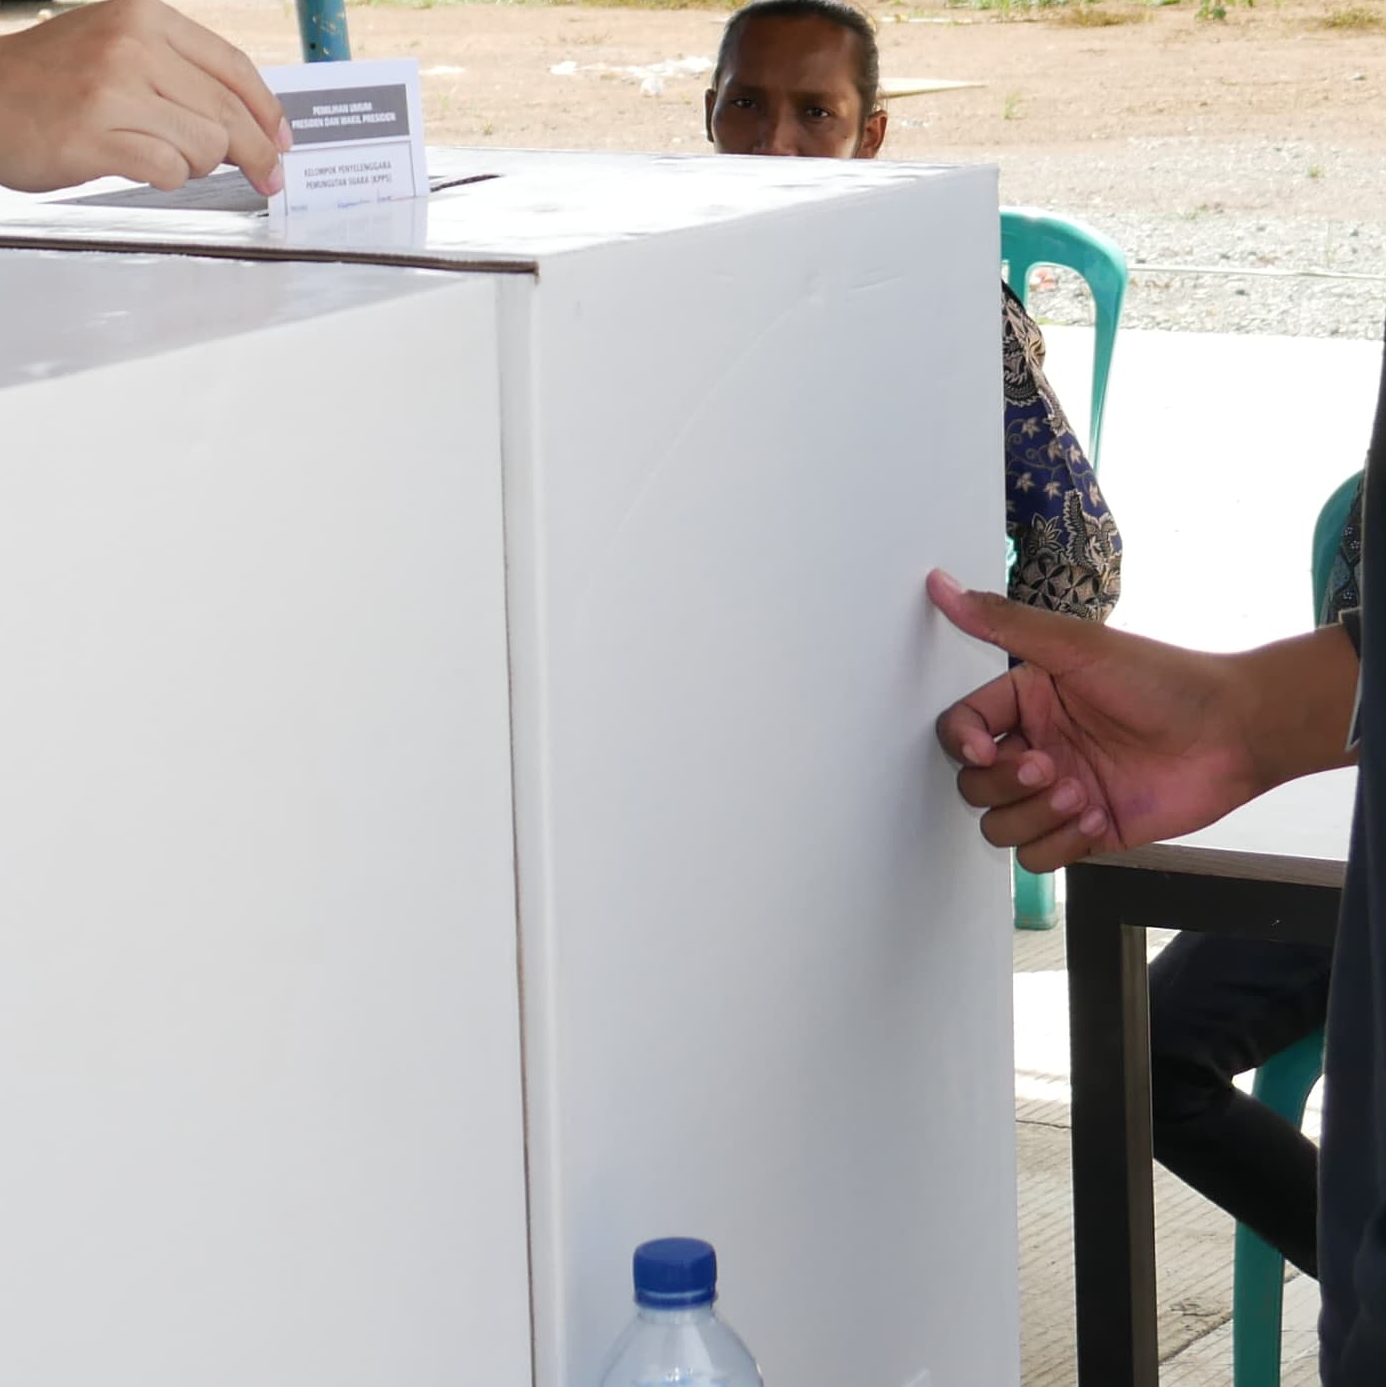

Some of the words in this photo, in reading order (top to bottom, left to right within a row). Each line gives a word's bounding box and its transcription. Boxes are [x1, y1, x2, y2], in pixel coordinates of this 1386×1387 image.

[291, 117, 324, 129] PRESIDEN
[324, 116, 340, 127] DAN
[362, 111, 396, 124] PRESIDEN
[304, 165, 337, 177] KELOMPOK
[338, 160, 392, 173] PENYELENGGARA
[305, 177, 347, 189] PEMUNGUTAN
